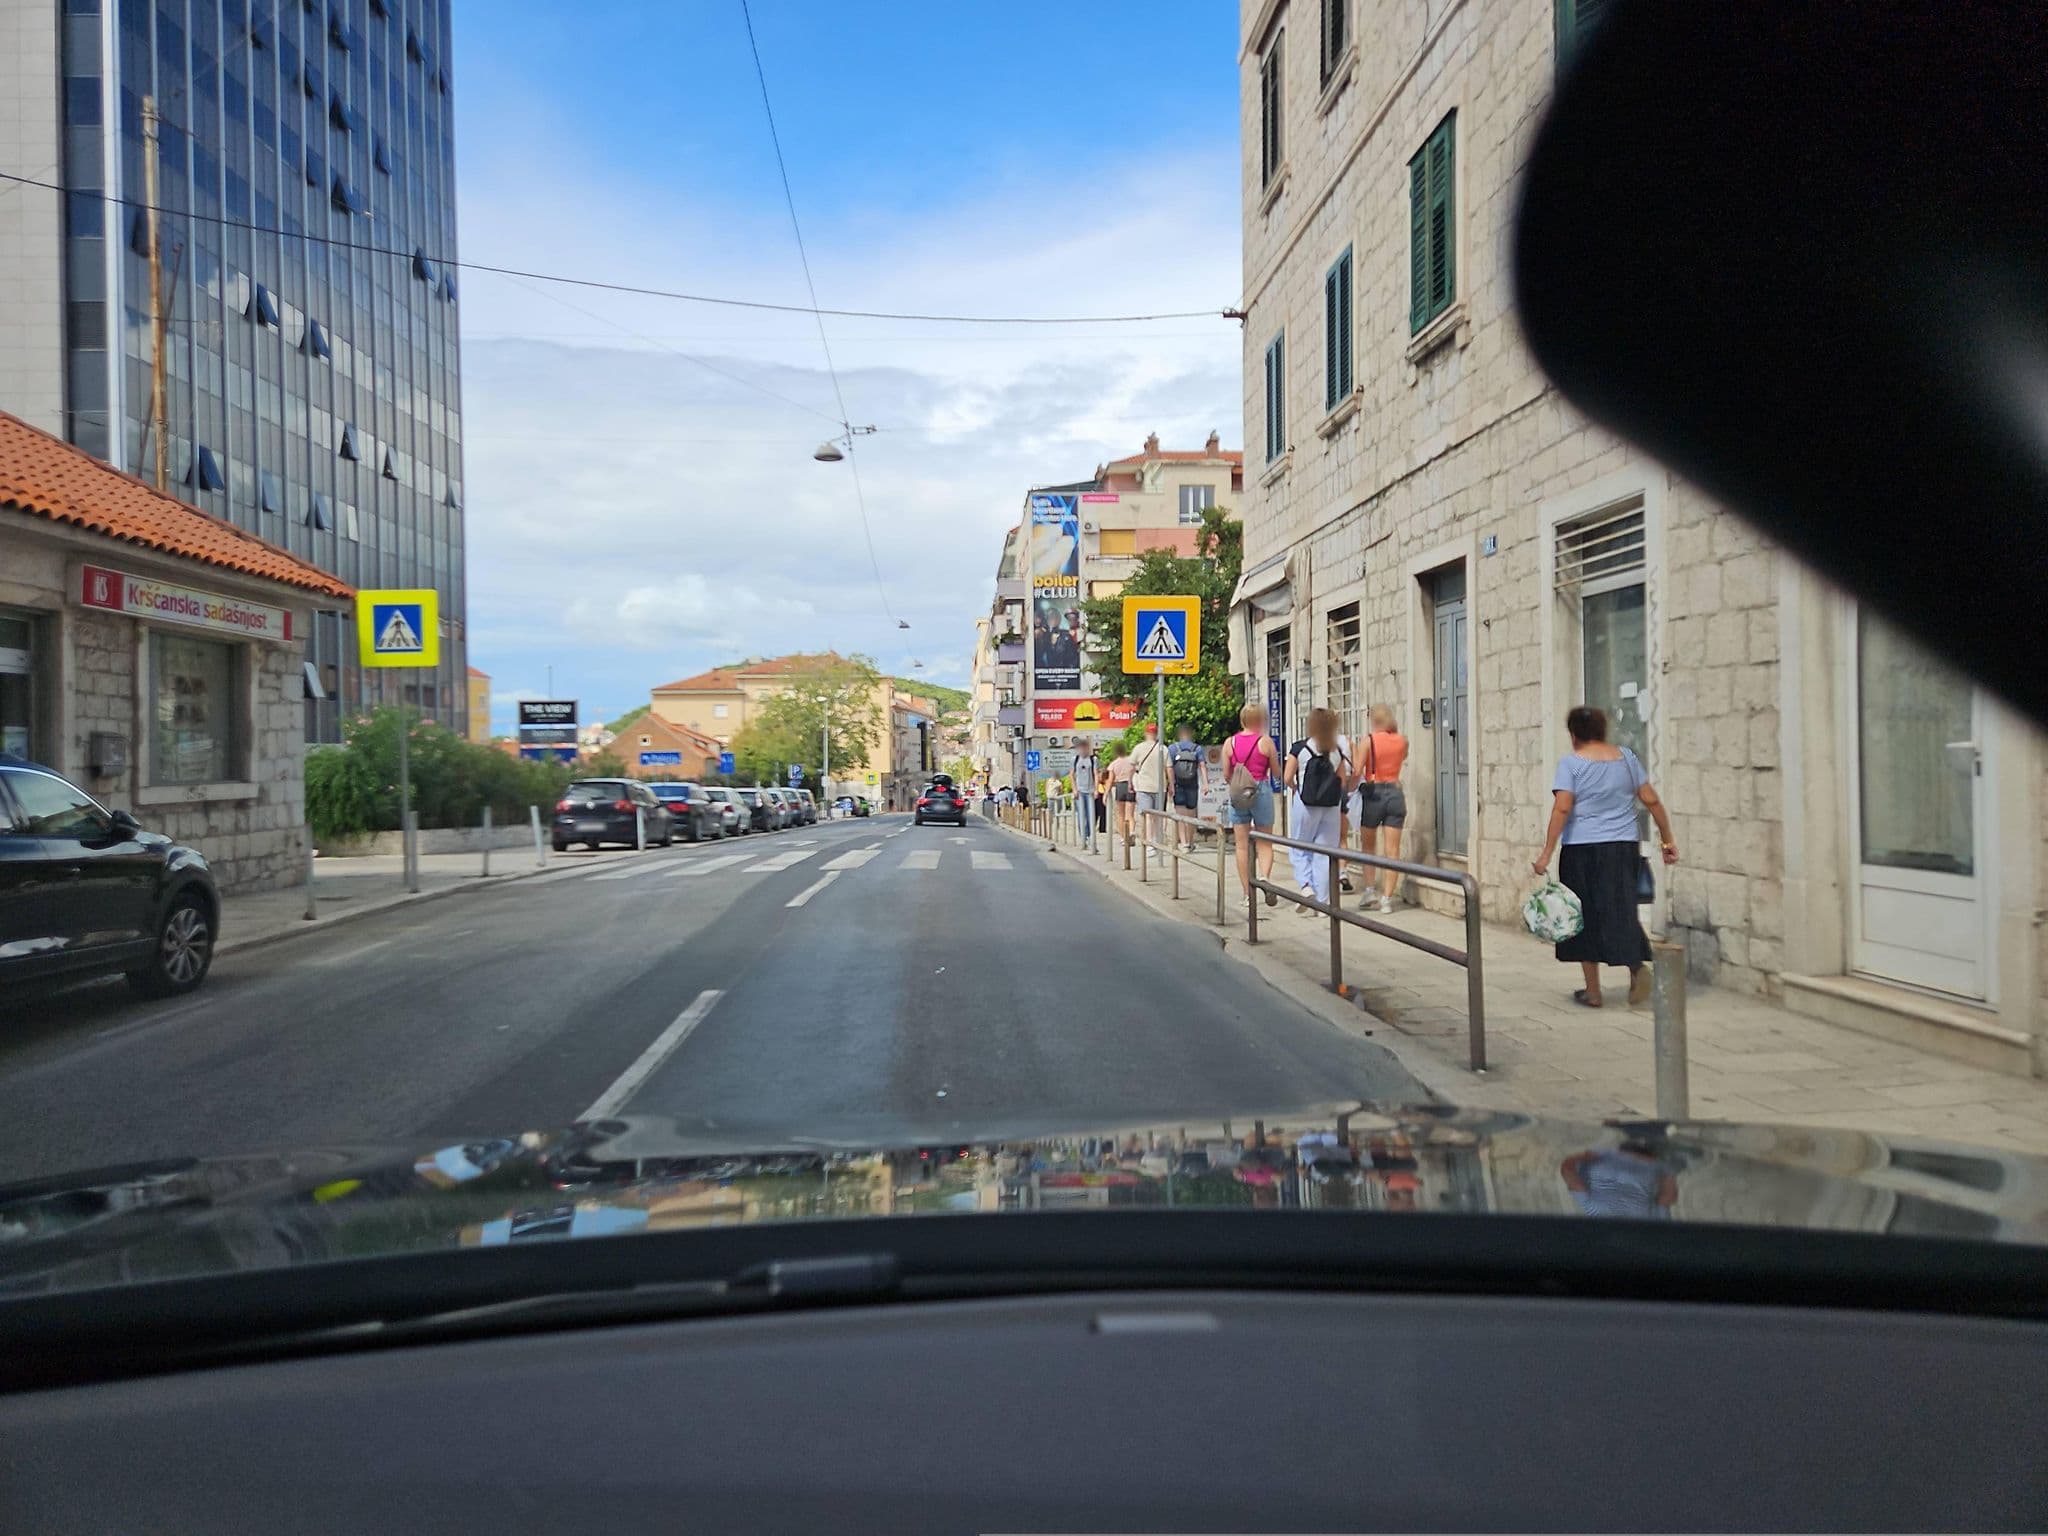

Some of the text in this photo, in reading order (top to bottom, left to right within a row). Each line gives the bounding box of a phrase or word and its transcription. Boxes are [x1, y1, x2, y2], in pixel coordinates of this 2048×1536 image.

[1034, 575, 1079, 587] boiler
[1034, 587, 1077, 599] #CLUB
[128, 584, 268, 630] Kršćanska sadašnjost
